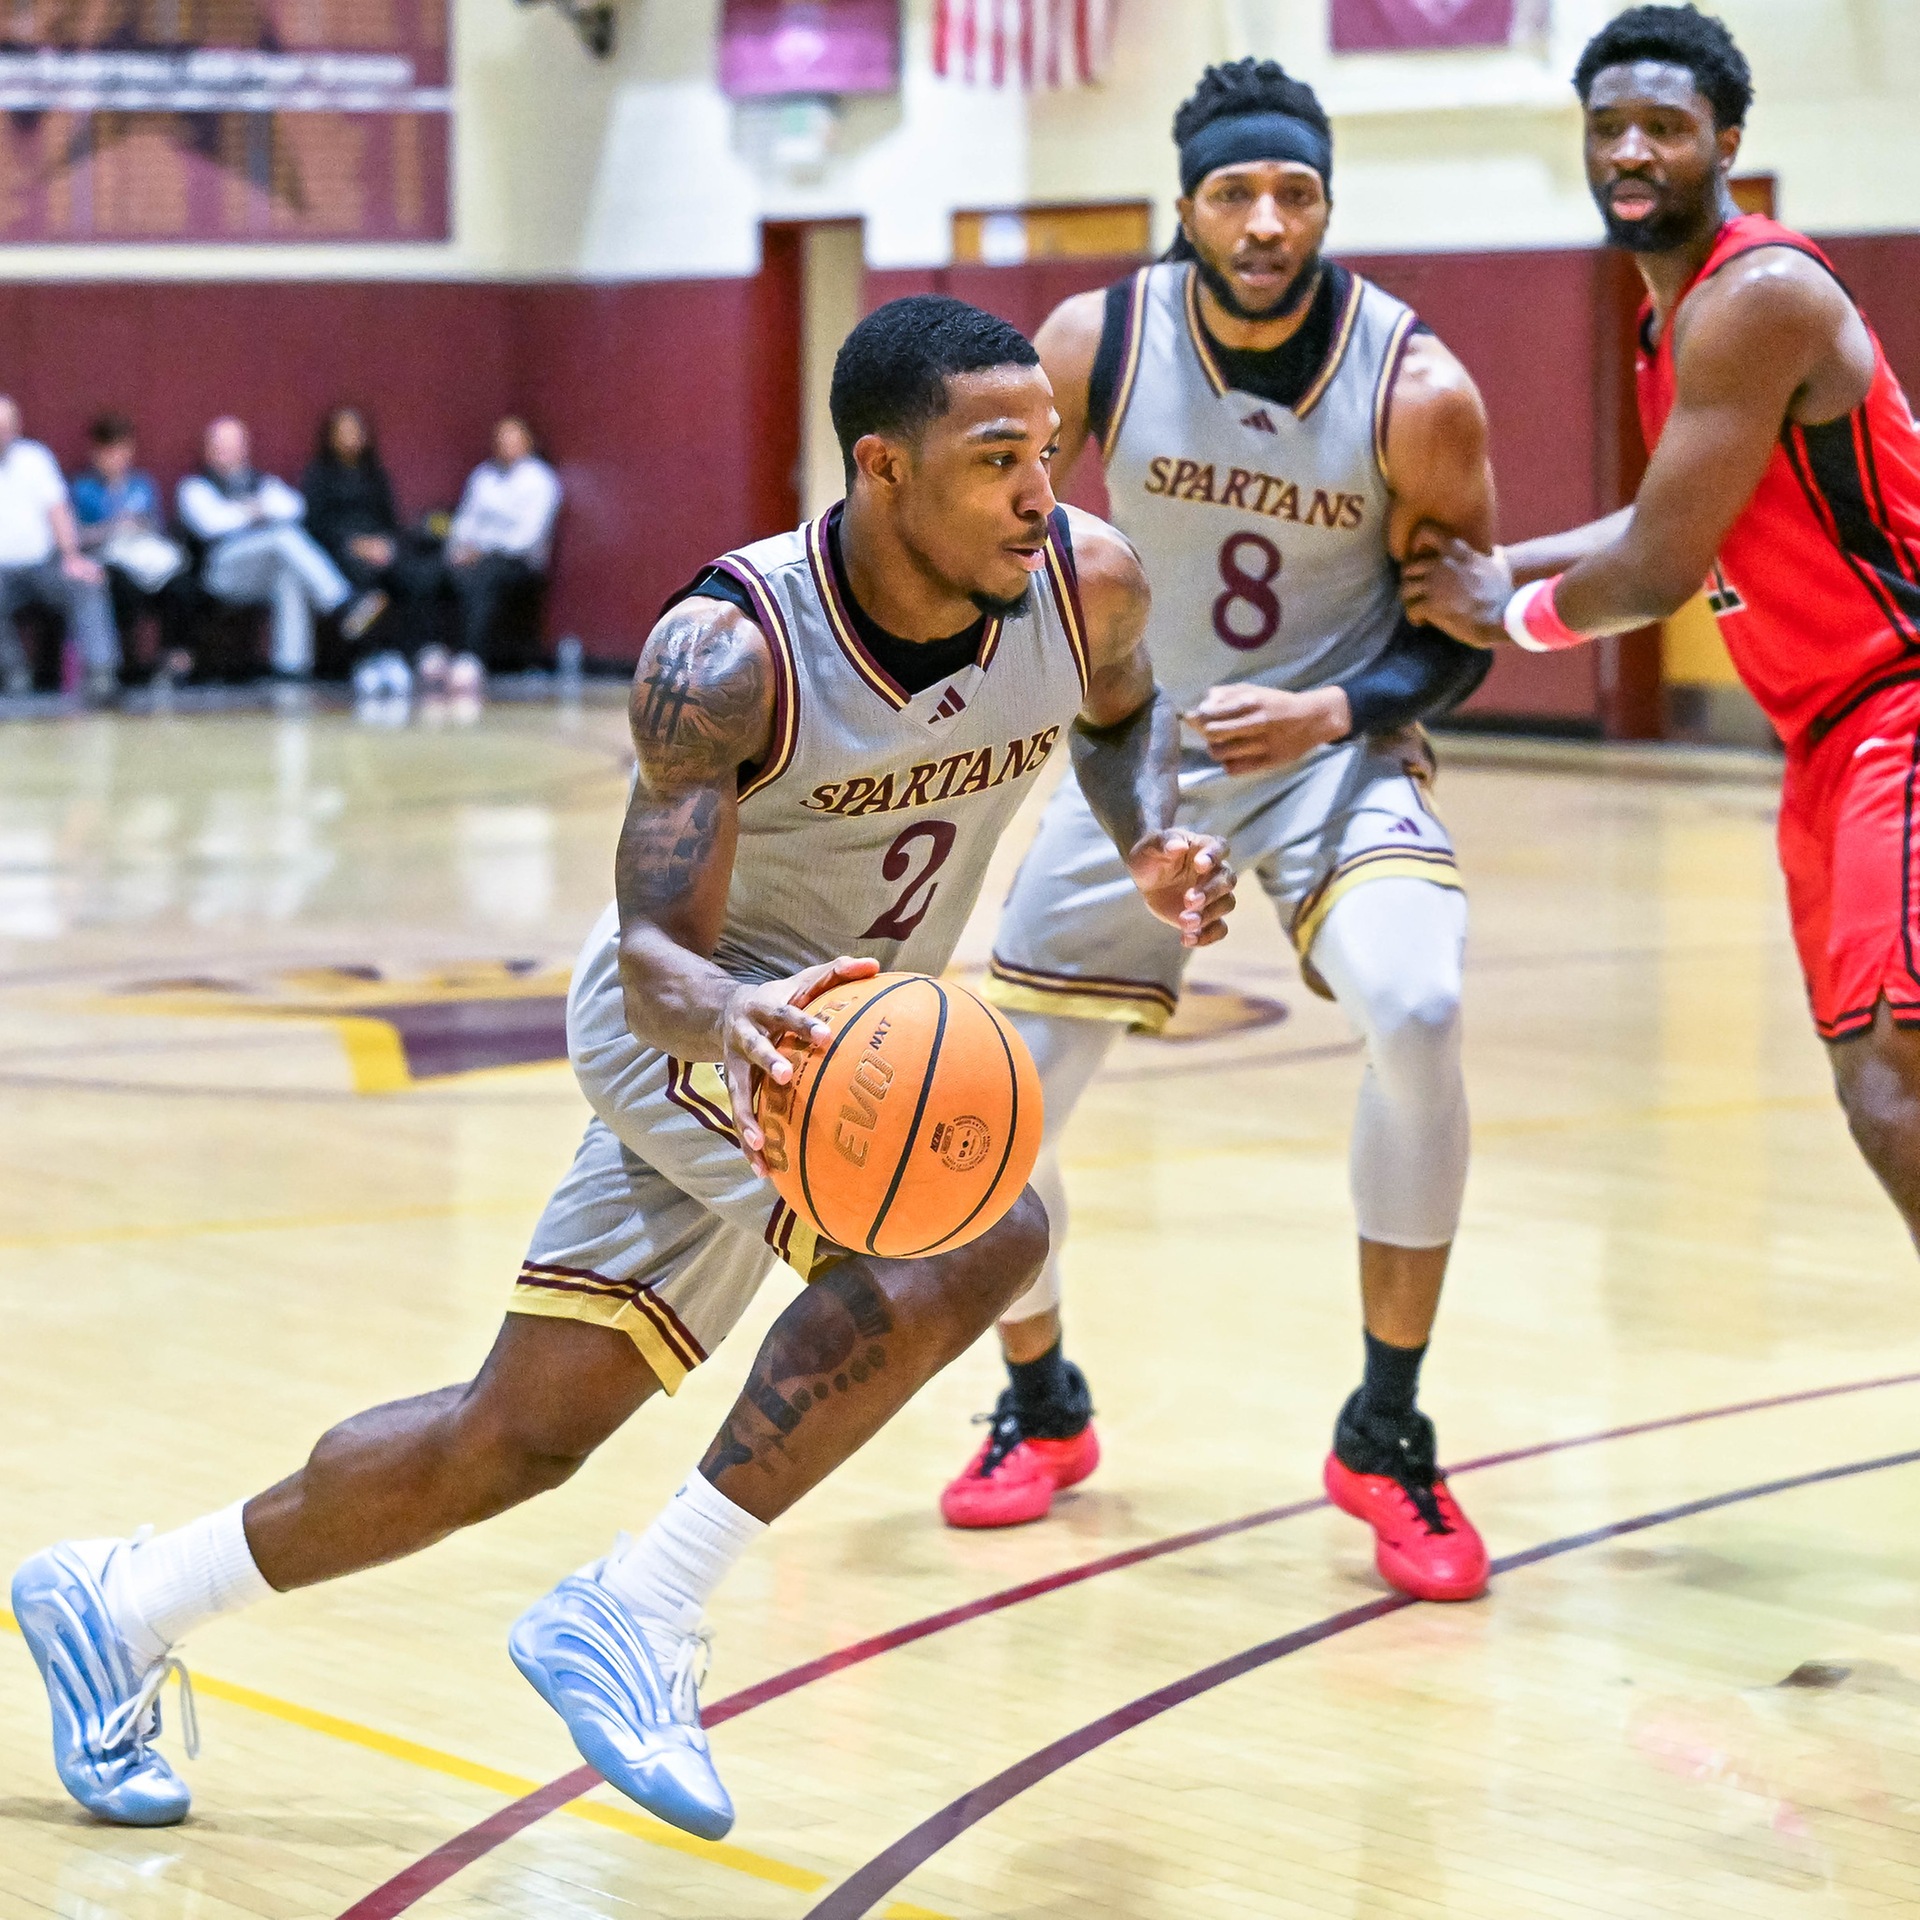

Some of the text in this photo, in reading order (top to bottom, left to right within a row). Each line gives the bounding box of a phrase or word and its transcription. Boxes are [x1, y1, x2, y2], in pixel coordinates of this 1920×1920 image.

[1143, 456, 1365, 530] SPARTANS
[1212, 529, 1282, 651] 8
[798, 724, 1062, 818] SPARTANS
[856, 819, 957, 941] 2
[834, 1016, 895, 1169] EVO NXT
